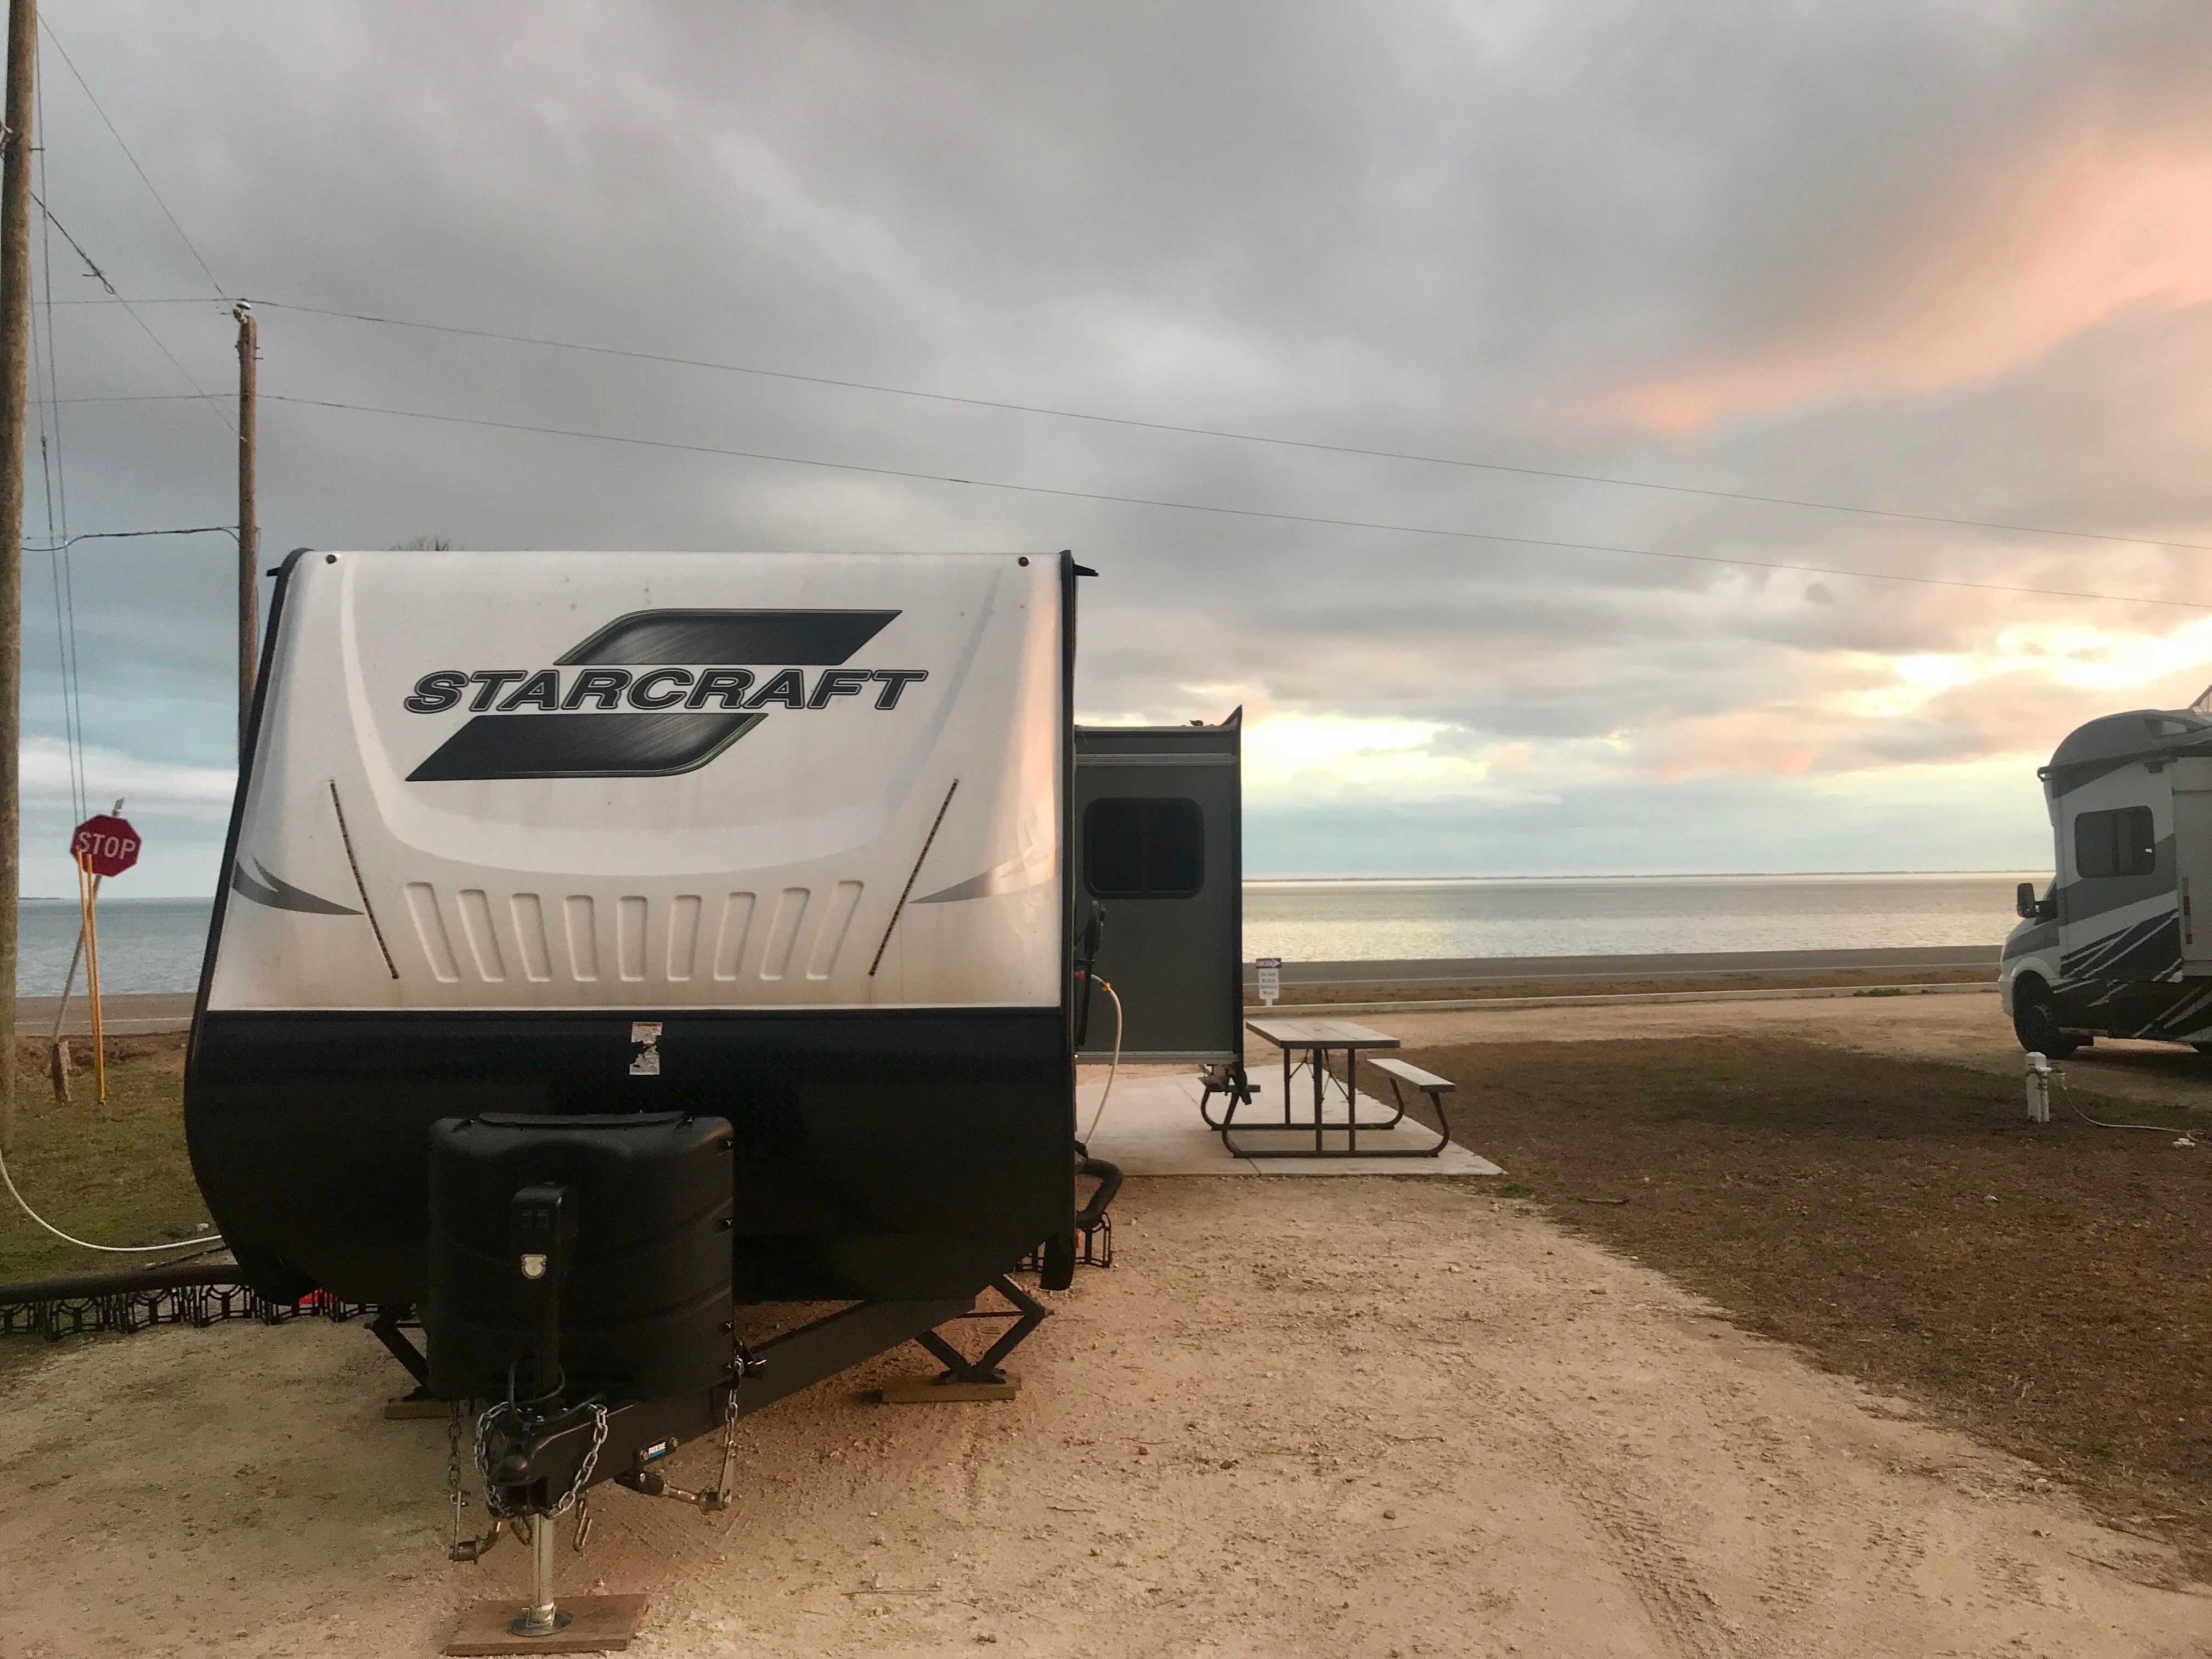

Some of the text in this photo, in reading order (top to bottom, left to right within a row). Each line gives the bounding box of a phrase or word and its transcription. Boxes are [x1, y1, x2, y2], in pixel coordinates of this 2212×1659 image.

[404, 669, 928, 714] STARCRAFT
[76, 831, 136, 860] STOP
[648, 1442, 666, 1454] REESE
